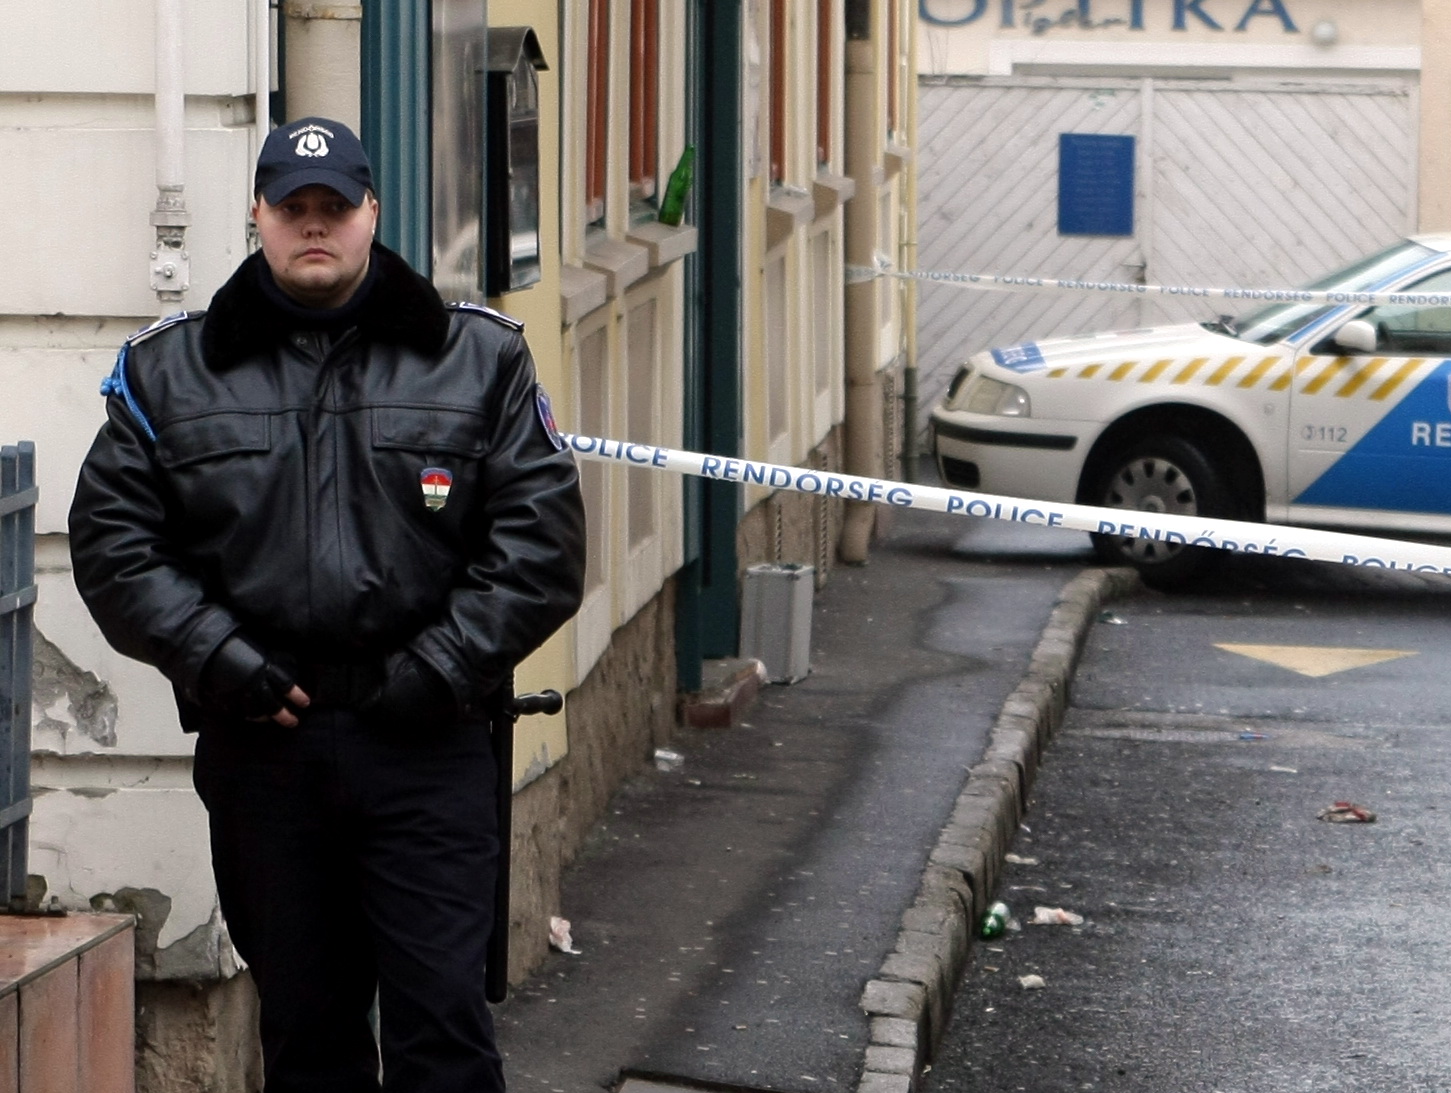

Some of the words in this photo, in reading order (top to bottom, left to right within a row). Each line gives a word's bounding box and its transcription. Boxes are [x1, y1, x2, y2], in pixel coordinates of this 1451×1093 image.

[1326, 292, 1376, 304] POLICE
[1318, 426, 1348, 442] 112
[561, 433, 669, 468] OLICE
[946, 495, 1064, 527] POLICE
